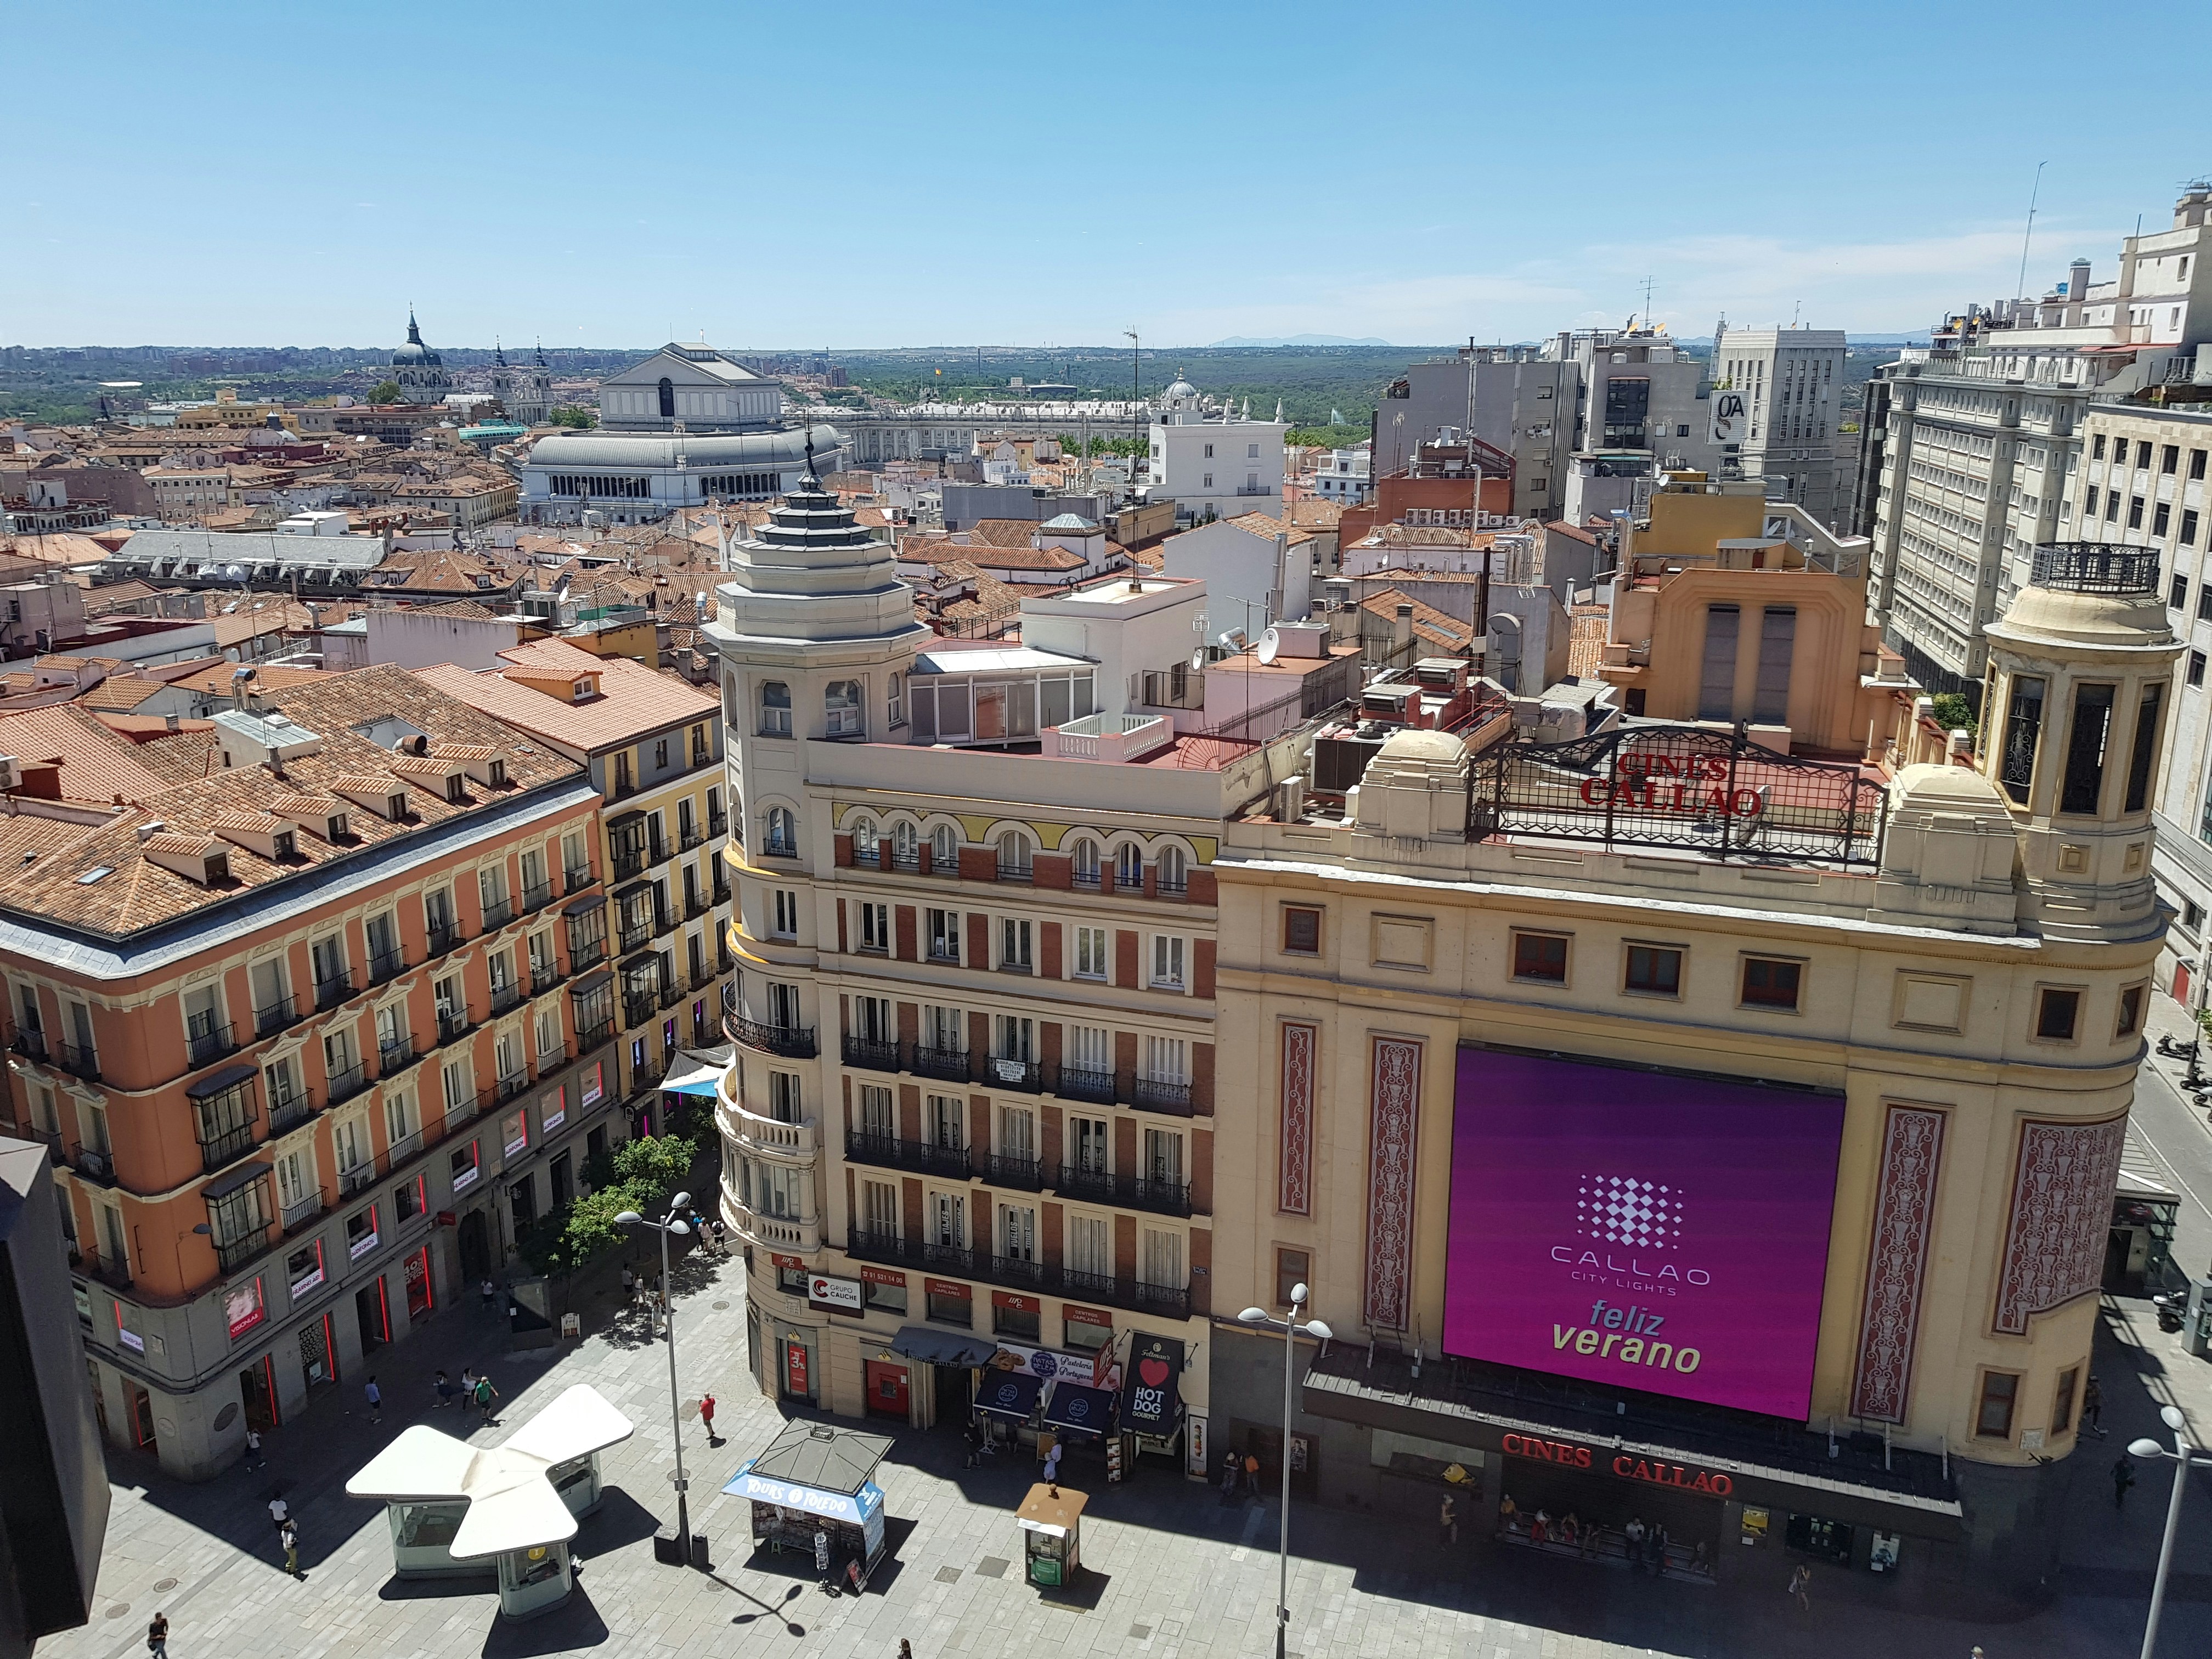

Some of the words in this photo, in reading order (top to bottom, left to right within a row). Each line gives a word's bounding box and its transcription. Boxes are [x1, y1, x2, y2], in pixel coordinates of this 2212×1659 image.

[1618, 752, 1728, 781] CINES
[1580, 777, 1761, 817] CALLAO
[1010, 1221, 1018, 1248] VUELOS
[1551, 1246, 1710, 1285] CALLAO
[830, 1284, 853, 1294] GRUPO
[934, 1288, 960, 1296] CAPILARES
[936, 1283, 958, 1291] CENTROS
[1571, 1271, 1607, 1284] CITY
[1616, 1278, 1677, 1296] LIGHTS
[830, 1291, 857, 1301] CALICHE
[1073, 1314, 1101, 1324] CAPILARES
[1075, 1310, 1098, 1318] CENTROS
[1590, 1299, 1664, 1336] feliz
[231, 1313, 258, 1333] VISIONLAB
[1553, 1323, 1701, 1373] verano
[1033, 1357, 1055, 1367] NATAS
[1059, 1367, 1093, 1381] Portuguesa
[1135, 1386, 1165, 1403] HOT
[1133, 1399, 1161, 1414] DOG
[1132, 1410, 1160, 1421] GOURMET
[1502, 1434, 1591, 1468] CINES
[1613, 1456, 1733, 1495] CALLAO
[746, 1479, 785, 1500] TOURS
[803, 1492, 847, 1513] TOLEDO
